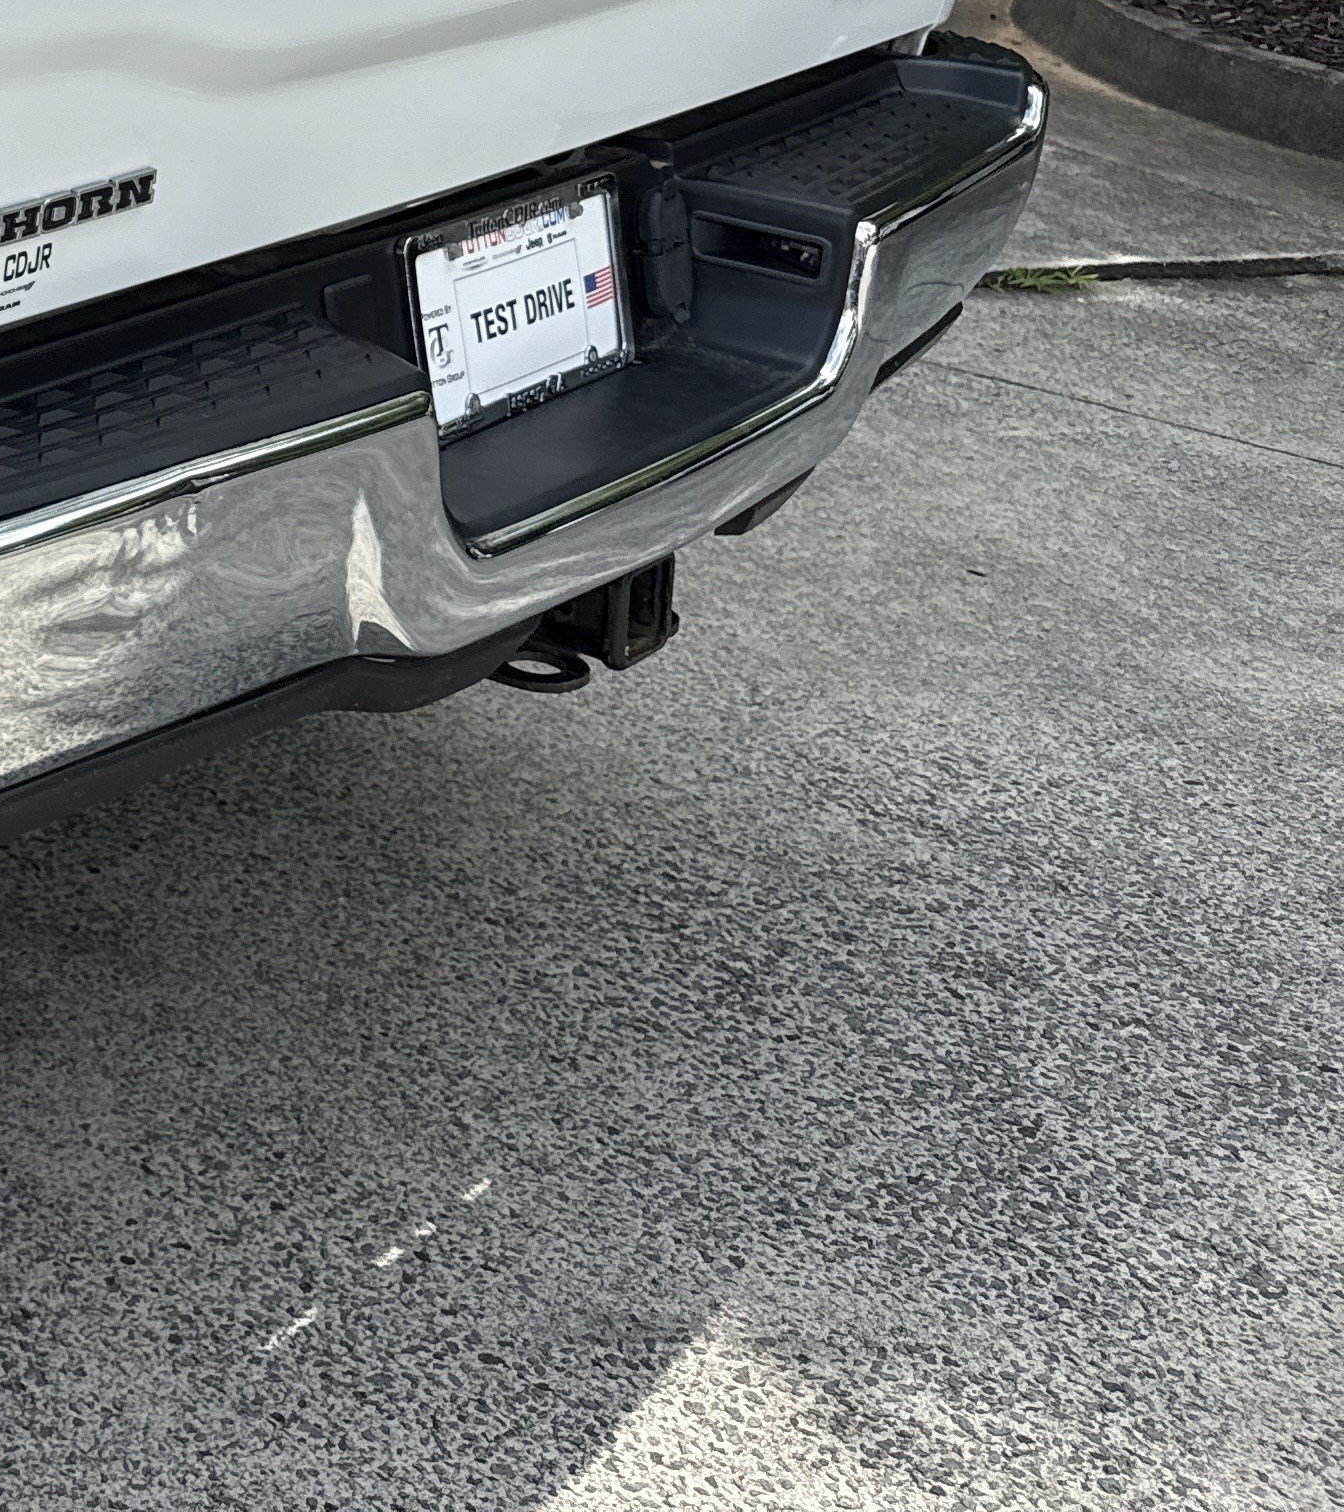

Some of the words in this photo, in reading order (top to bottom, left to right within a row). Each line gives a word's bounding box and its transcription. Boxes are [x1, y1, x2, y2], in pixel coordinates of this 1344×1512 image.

[3, 242, 53, 282] CDJR
[0, 300, 21, 312] RAM
[470, 299, 517, 343] TEST
[523, 278, 575, 326] DRIVE
